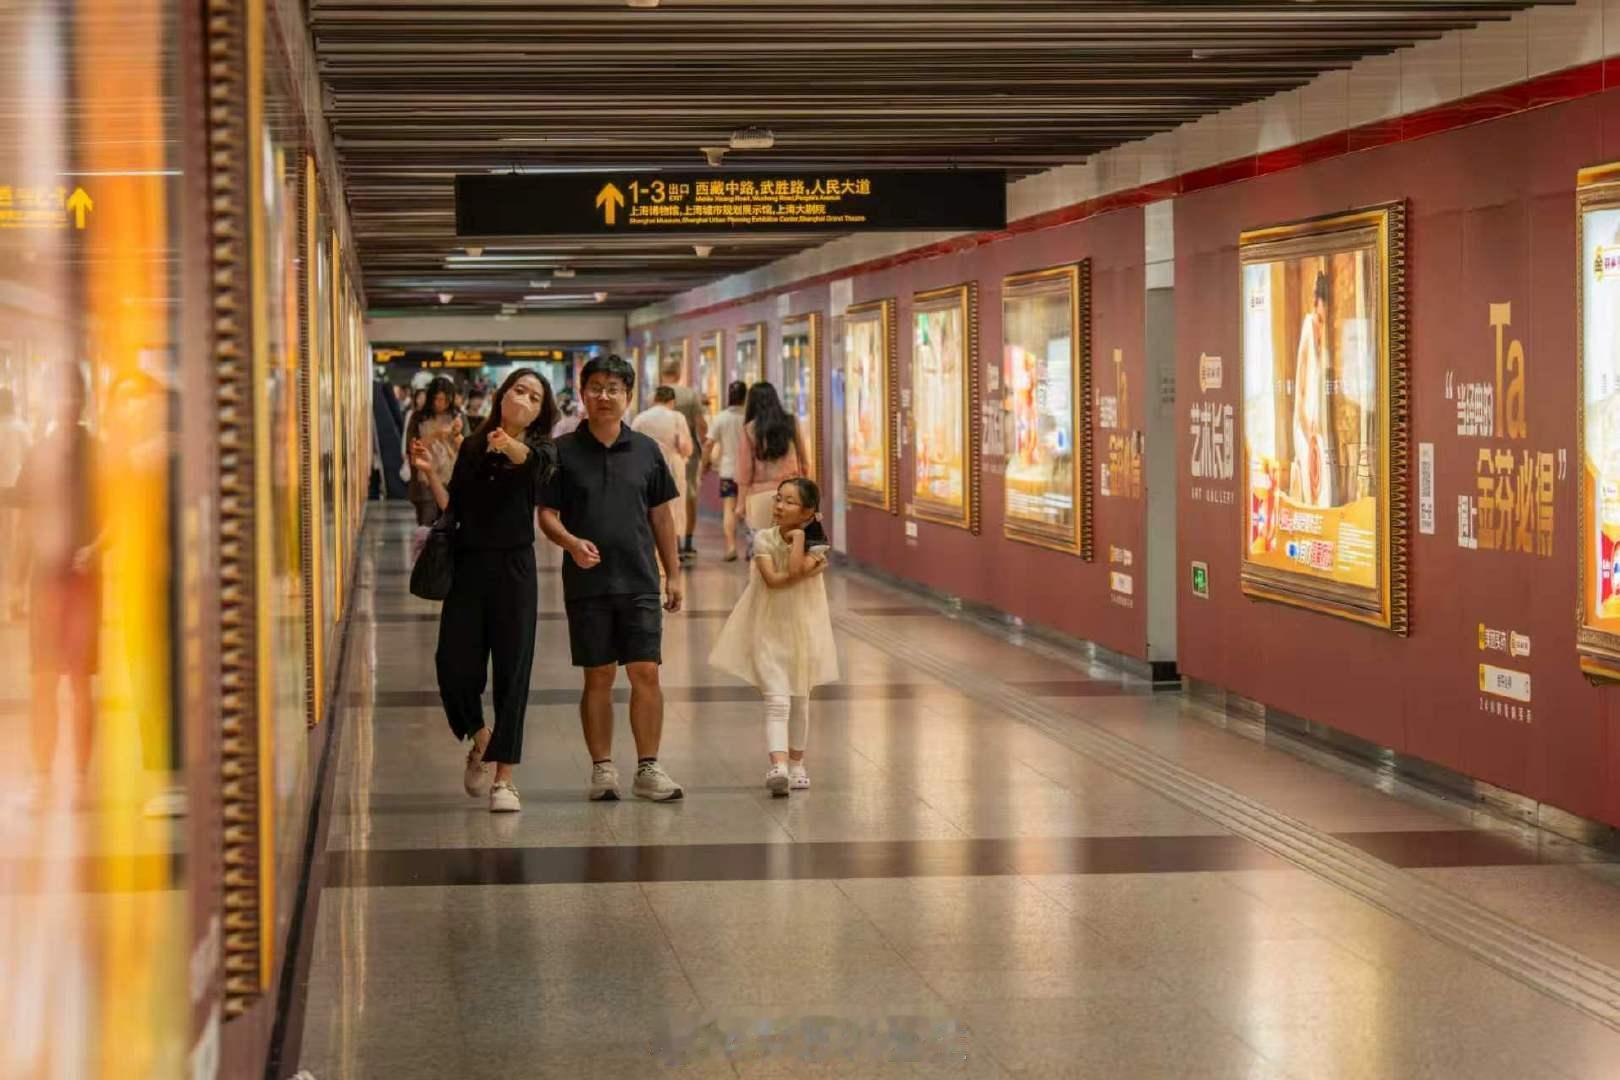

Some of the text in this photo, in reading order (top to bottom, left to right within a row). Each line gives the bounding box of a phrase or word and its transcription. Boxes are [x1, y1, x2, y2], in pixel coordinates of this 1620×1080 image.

[628, 180, 666, 204] 1-3
[668, 183, 690, 195] 出口
[1190, 401, 1234, 480] 艺术长廊
